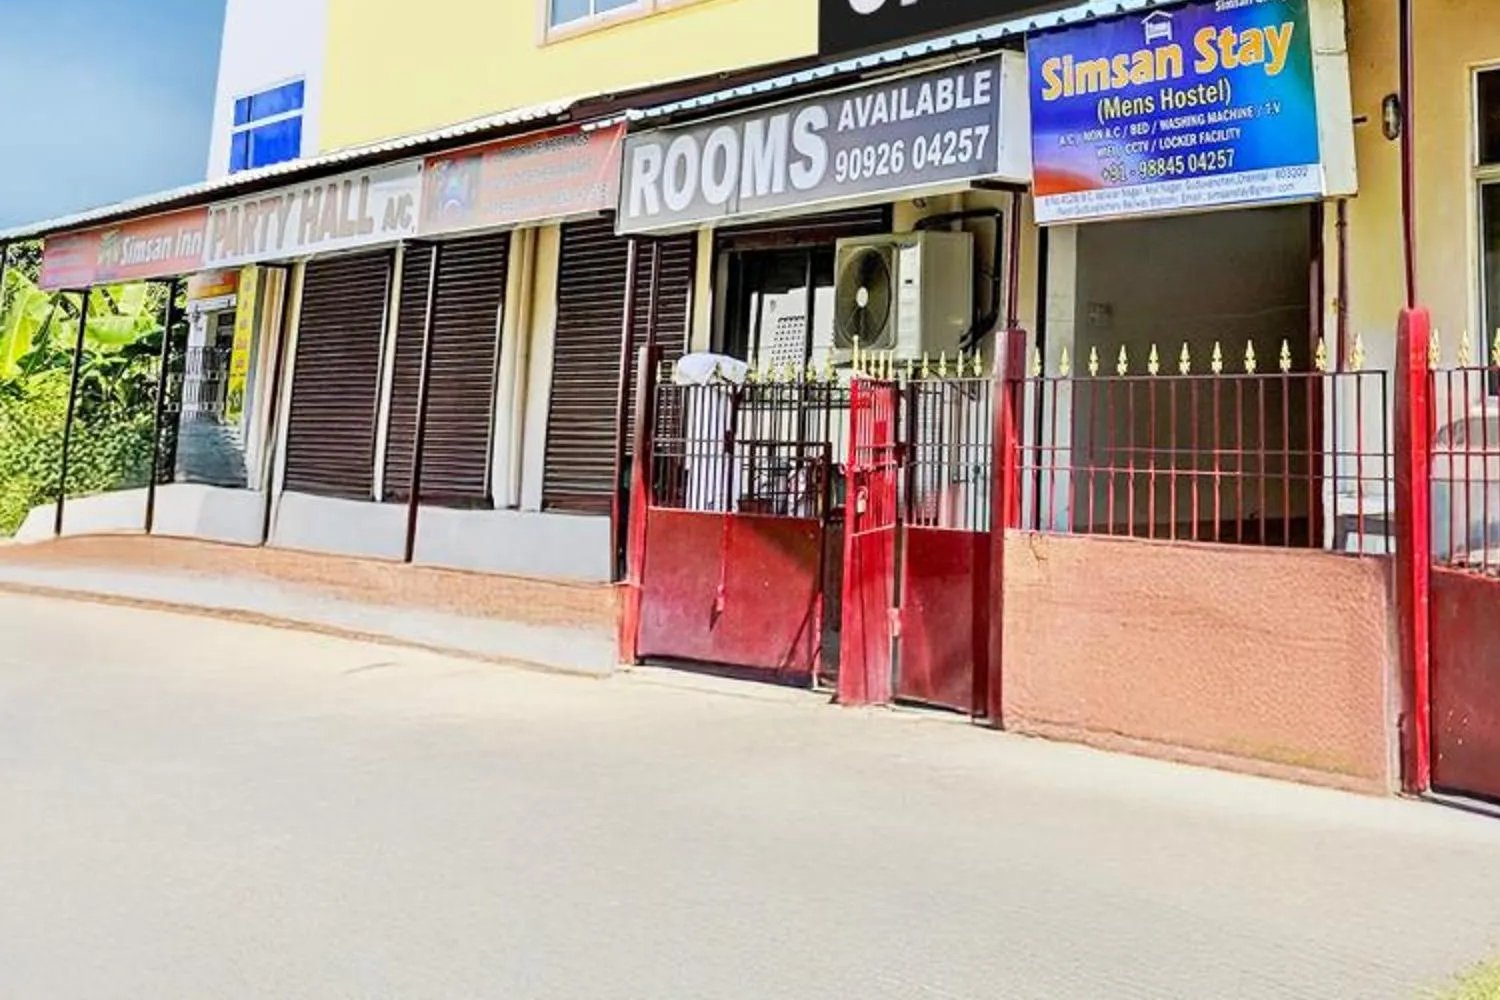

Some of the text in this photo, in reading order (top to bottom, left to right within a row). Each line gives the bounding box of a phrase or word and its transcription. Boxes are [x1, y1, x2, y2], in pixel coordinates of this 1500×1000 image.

[1041, 21, 1295, 101] Simsan Stay
[1097, 77, 1231, 126] (Mens Hostel)
[1129, 121, 1151, 136] BED
[1160, 113, 1206, 131] WASHING
[1207, 105, 1254, 125] MACHINE
[629, 69, 993, 218] ROOMS AVAILABLE
[835, 126, 990, 184] 90926 04257
[1125, 140, 1149, 155] CCTV
[1159, 133, 1197, 151] LOCKER
[1199, 126, 1241, 144] FACILITY
[1139, 155, 1185, 178] 98845
[1187, 147, 1235, 173] 04257
[210, 193, 295, 261] PARTY
[298, 175, 375, 245] HALL
[120, 235, 172, 266] Simsan
[176, 227, 202, 258] Inn
